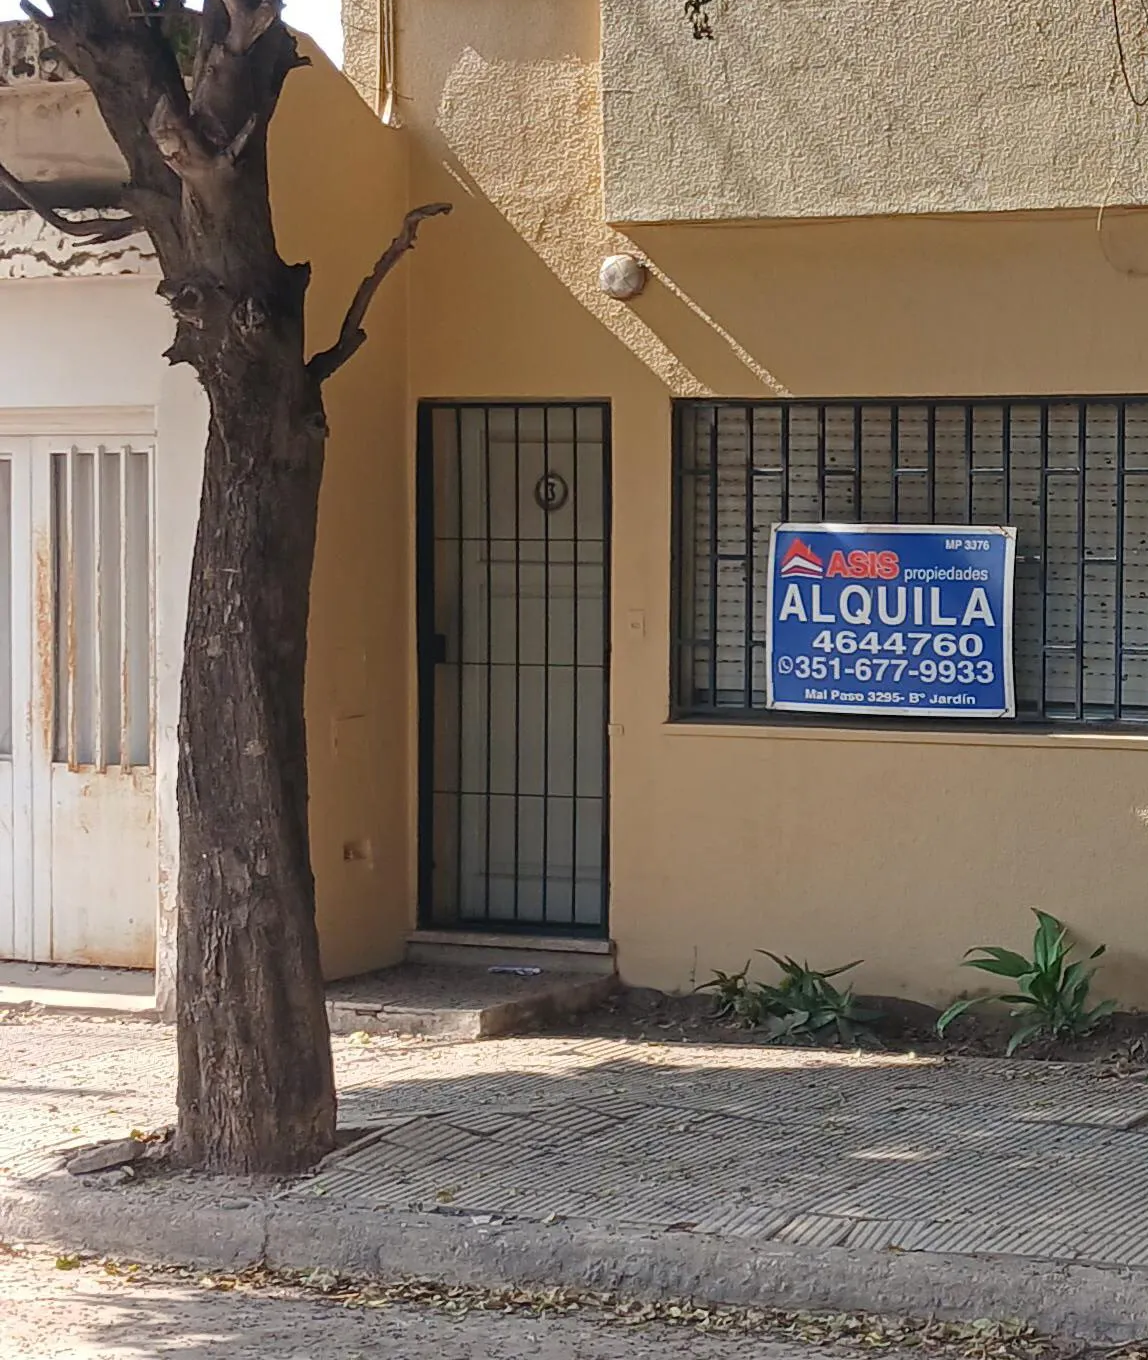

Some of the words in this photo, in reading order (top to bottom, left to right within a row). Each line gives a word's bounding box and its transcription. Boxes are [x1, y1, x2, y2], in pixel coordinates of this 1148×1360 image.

[945, 539, 962, 550] MP
[826, 550, 900, 580] ASIS
[904, 566, 989, 582] propiedades
[778, 583, 996, 627] ALQUILA
[812, 630, 984, 657] 4644760
[795, 656, 995, 684] 351-677-9933
[805, 689, 828, 700] Mal
[831, 690, 865, 702] Paso
[867, 691, 906, 703] 3295-
[930, 693, 977, 705] Jardín
